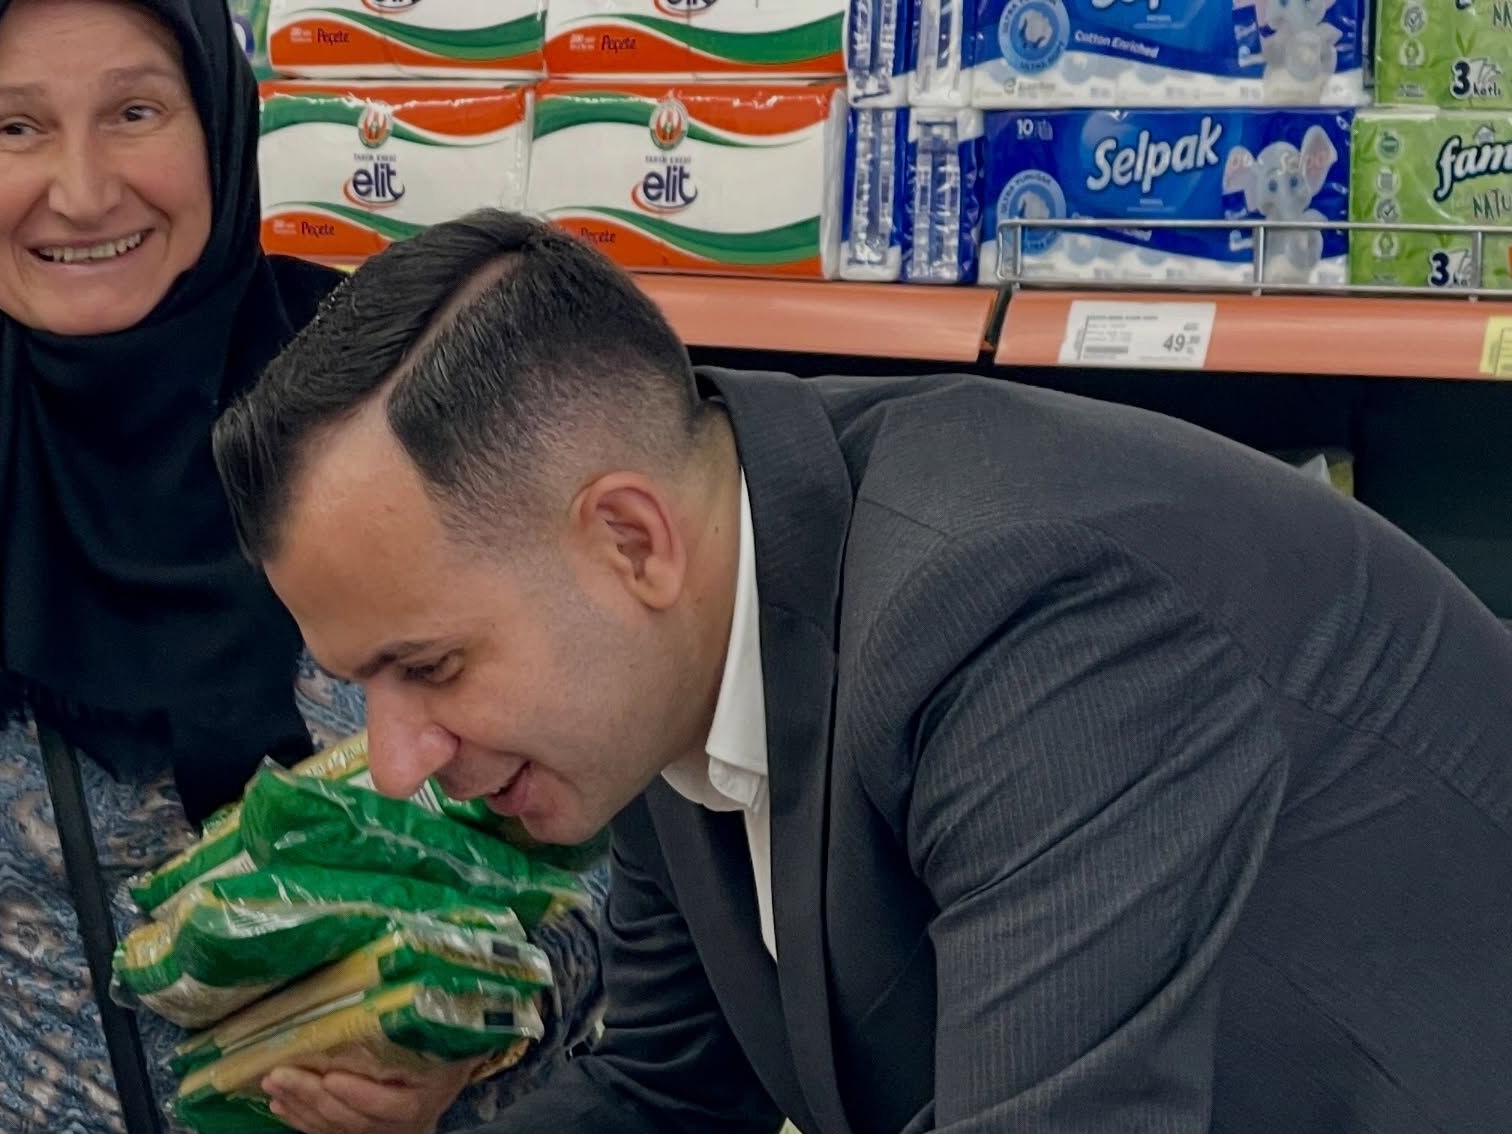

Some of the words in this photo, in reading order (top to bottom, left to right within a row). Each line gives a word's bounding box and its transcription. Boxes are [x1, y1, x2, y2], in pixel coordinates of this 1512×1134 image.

[1453, 60, 1470, 95] 3
[1017, 119, 1033, 136] 10
[1086, 116, 1223, 194] Selpak
[352, 163, 406, 199] elit
[643, 165, 699, 206] elit
[1430, 252, 1450, 288] 3
